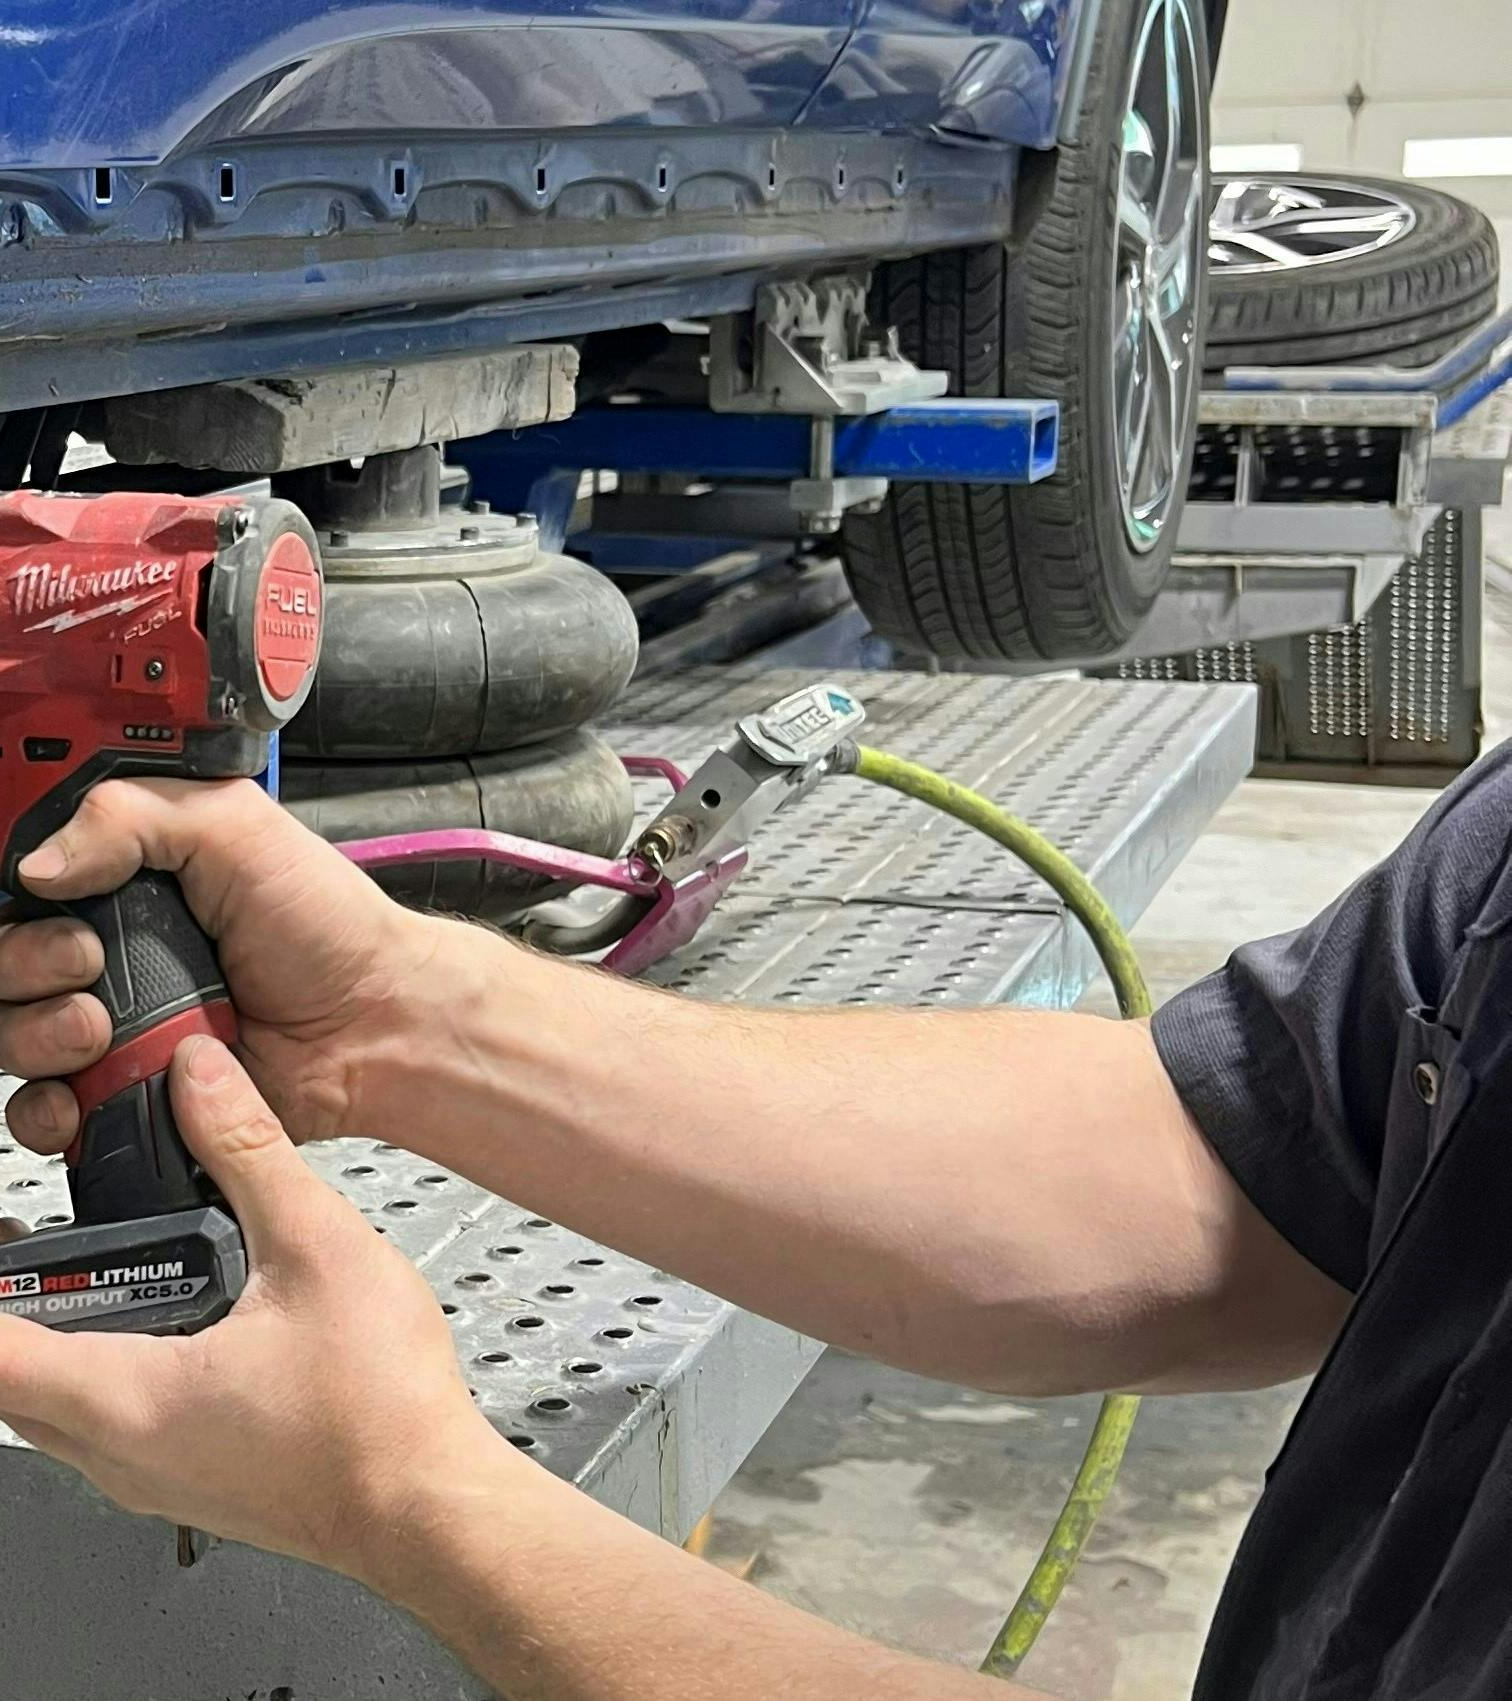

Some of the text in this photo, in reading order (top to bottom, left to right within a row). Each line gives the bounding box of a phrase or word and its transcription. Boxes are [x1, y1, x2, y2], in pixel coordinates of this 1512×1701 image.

[7, 558, 178, 614] Milwaukee
[266, 582, 317, 616] FUEL
[45, 1289, 126, 1312] OUTPUT
[129, 1282, 193, 1302] XC5.0
